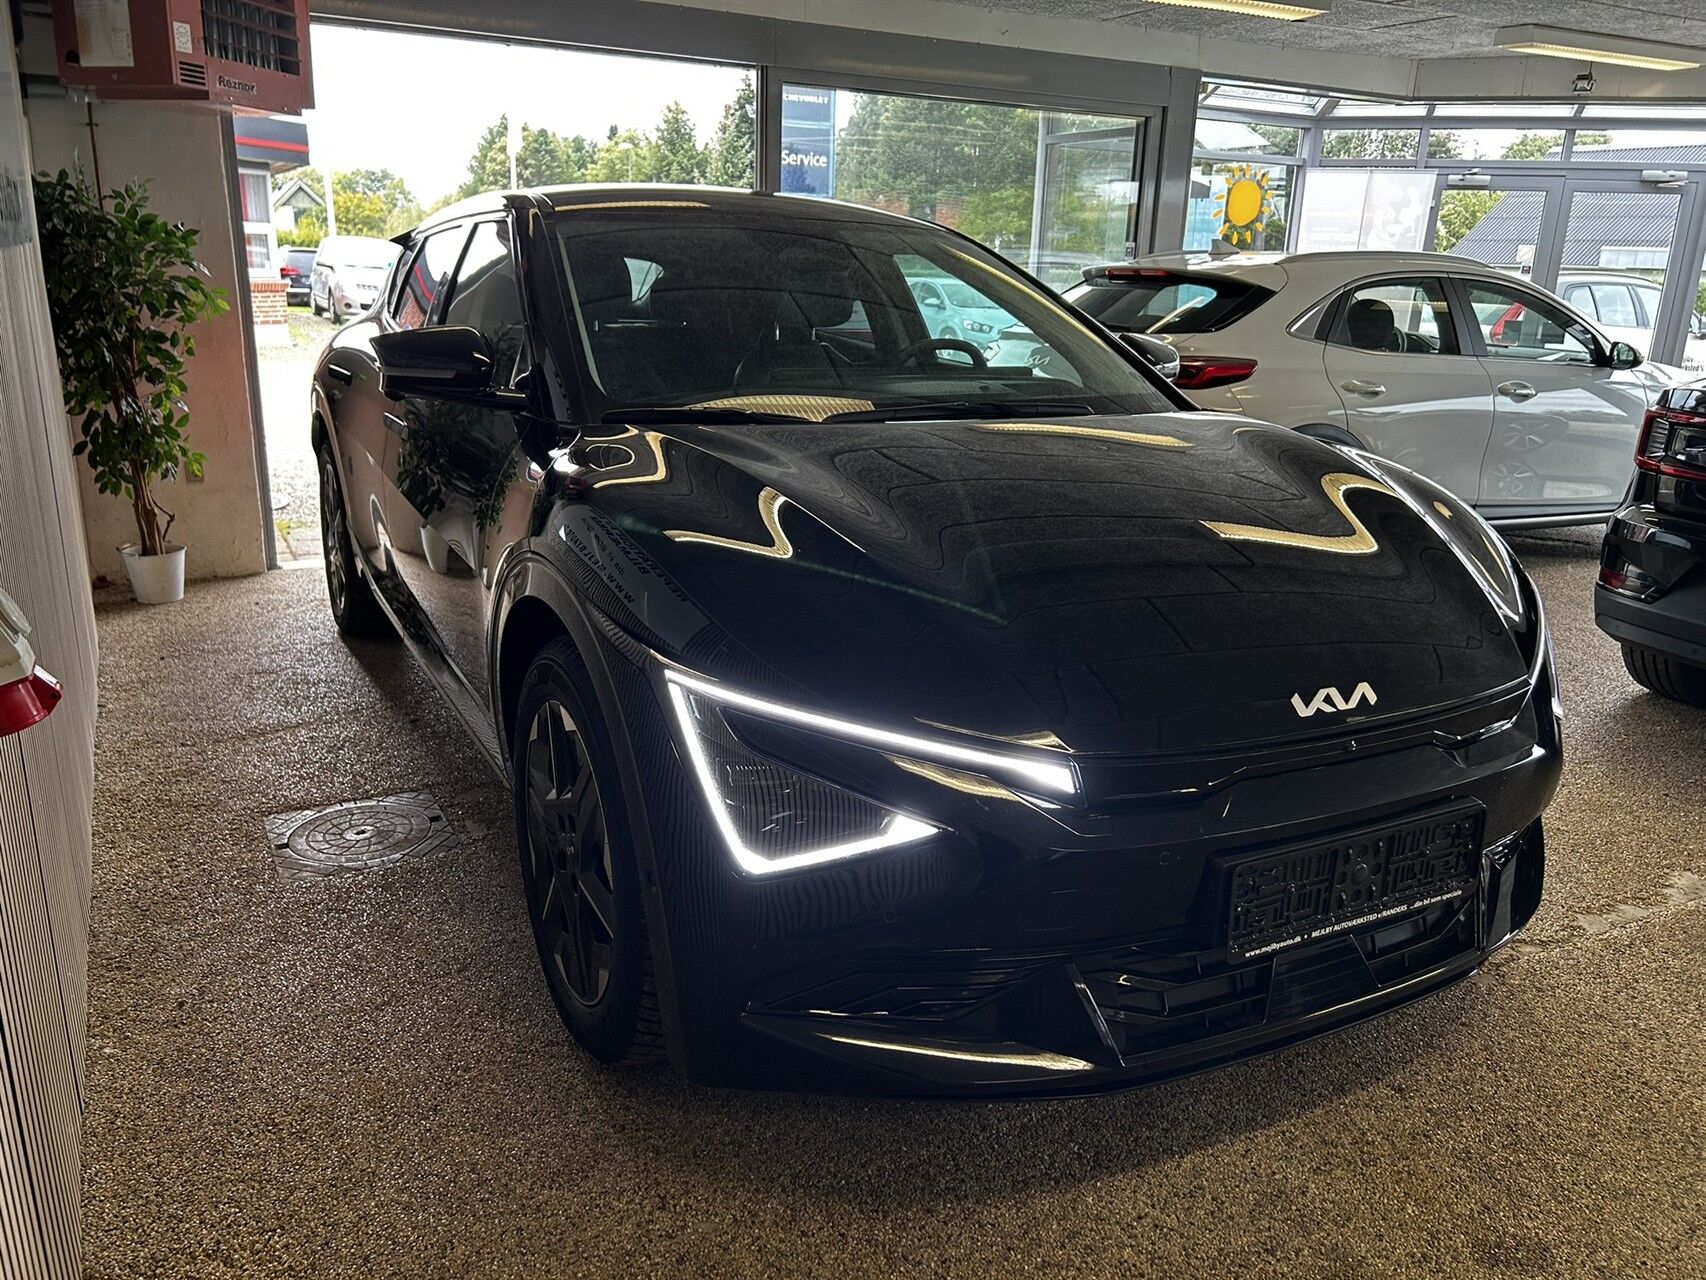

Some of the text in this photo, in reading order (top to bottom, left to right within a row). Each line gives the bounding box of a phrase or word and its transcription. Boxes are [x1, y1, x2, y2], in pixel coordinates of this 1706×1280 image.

[218, 75, 256, 93] Reznor
[781, 149, 828, 167] Service
[1290, 681, 1378, 718] KIA
[1244, 935, 1302, 958] www.mejlbyauto.dk
[1311, 925, 1334, 938] MEJLBY
[1423, 897, 1431, 906] bil
[1430, 895, 1442, 904] som
